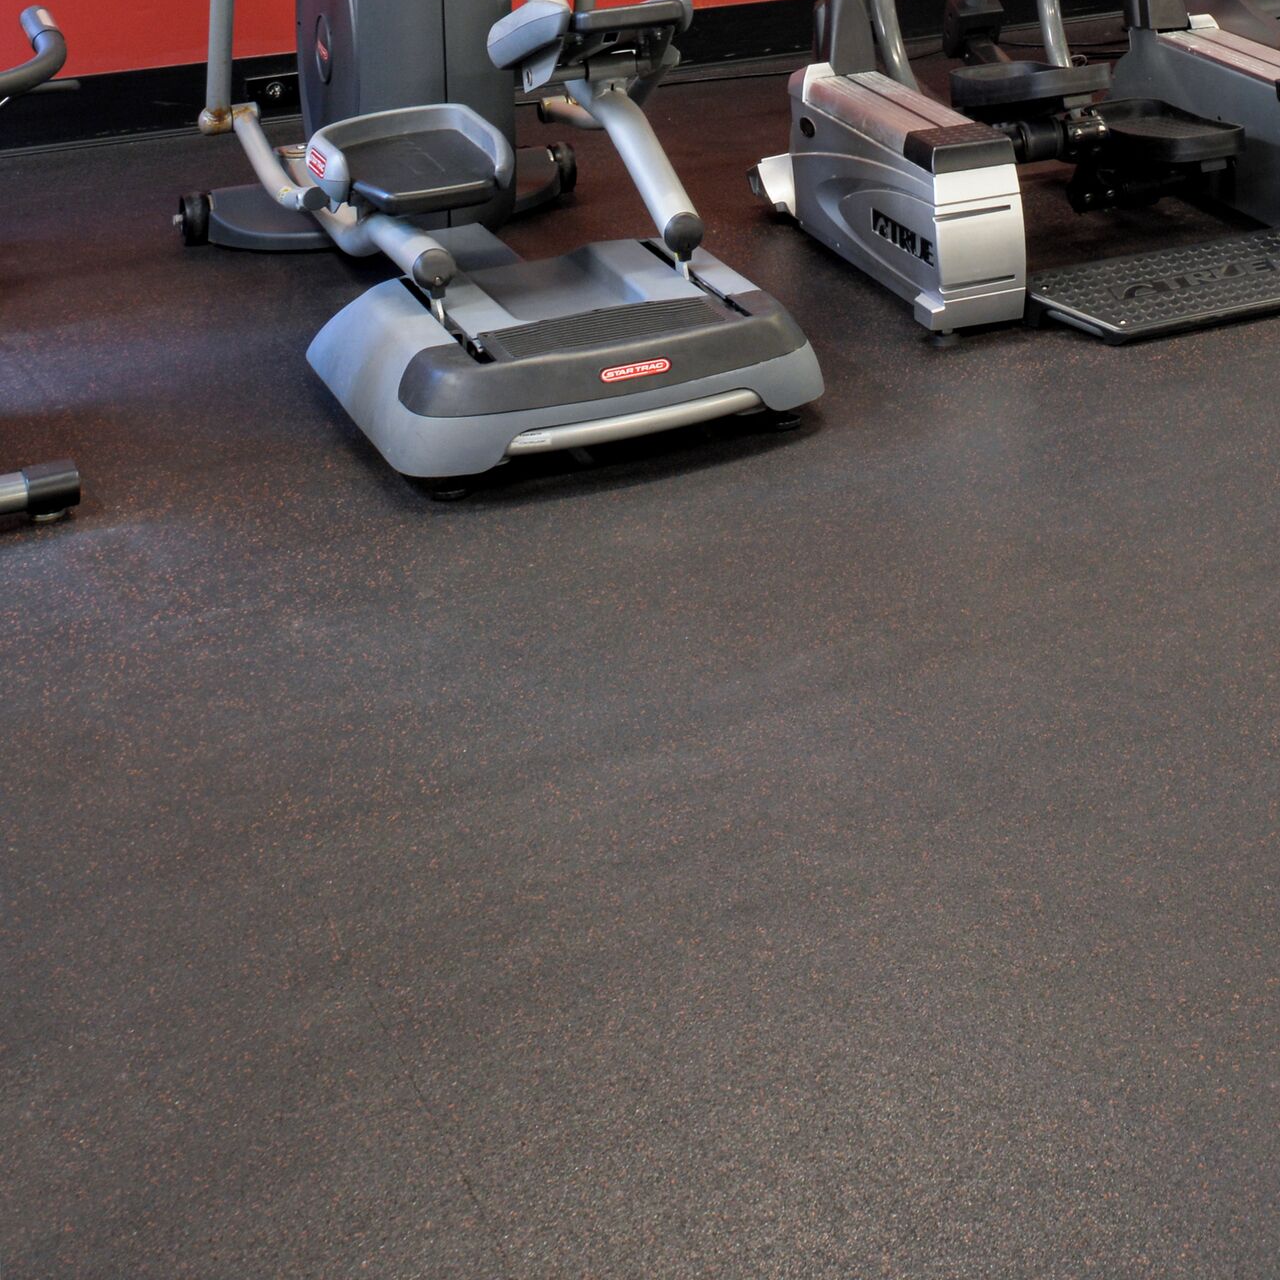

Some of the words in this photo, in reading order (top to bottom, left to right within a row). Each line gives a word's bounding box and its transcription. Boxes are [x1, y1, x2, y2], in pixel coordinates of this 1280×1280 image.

[1150, 258, 1277, 293] TRUE
[605, 368, 634, 378] STAR
[635, 362, 664, 372] TRAC
